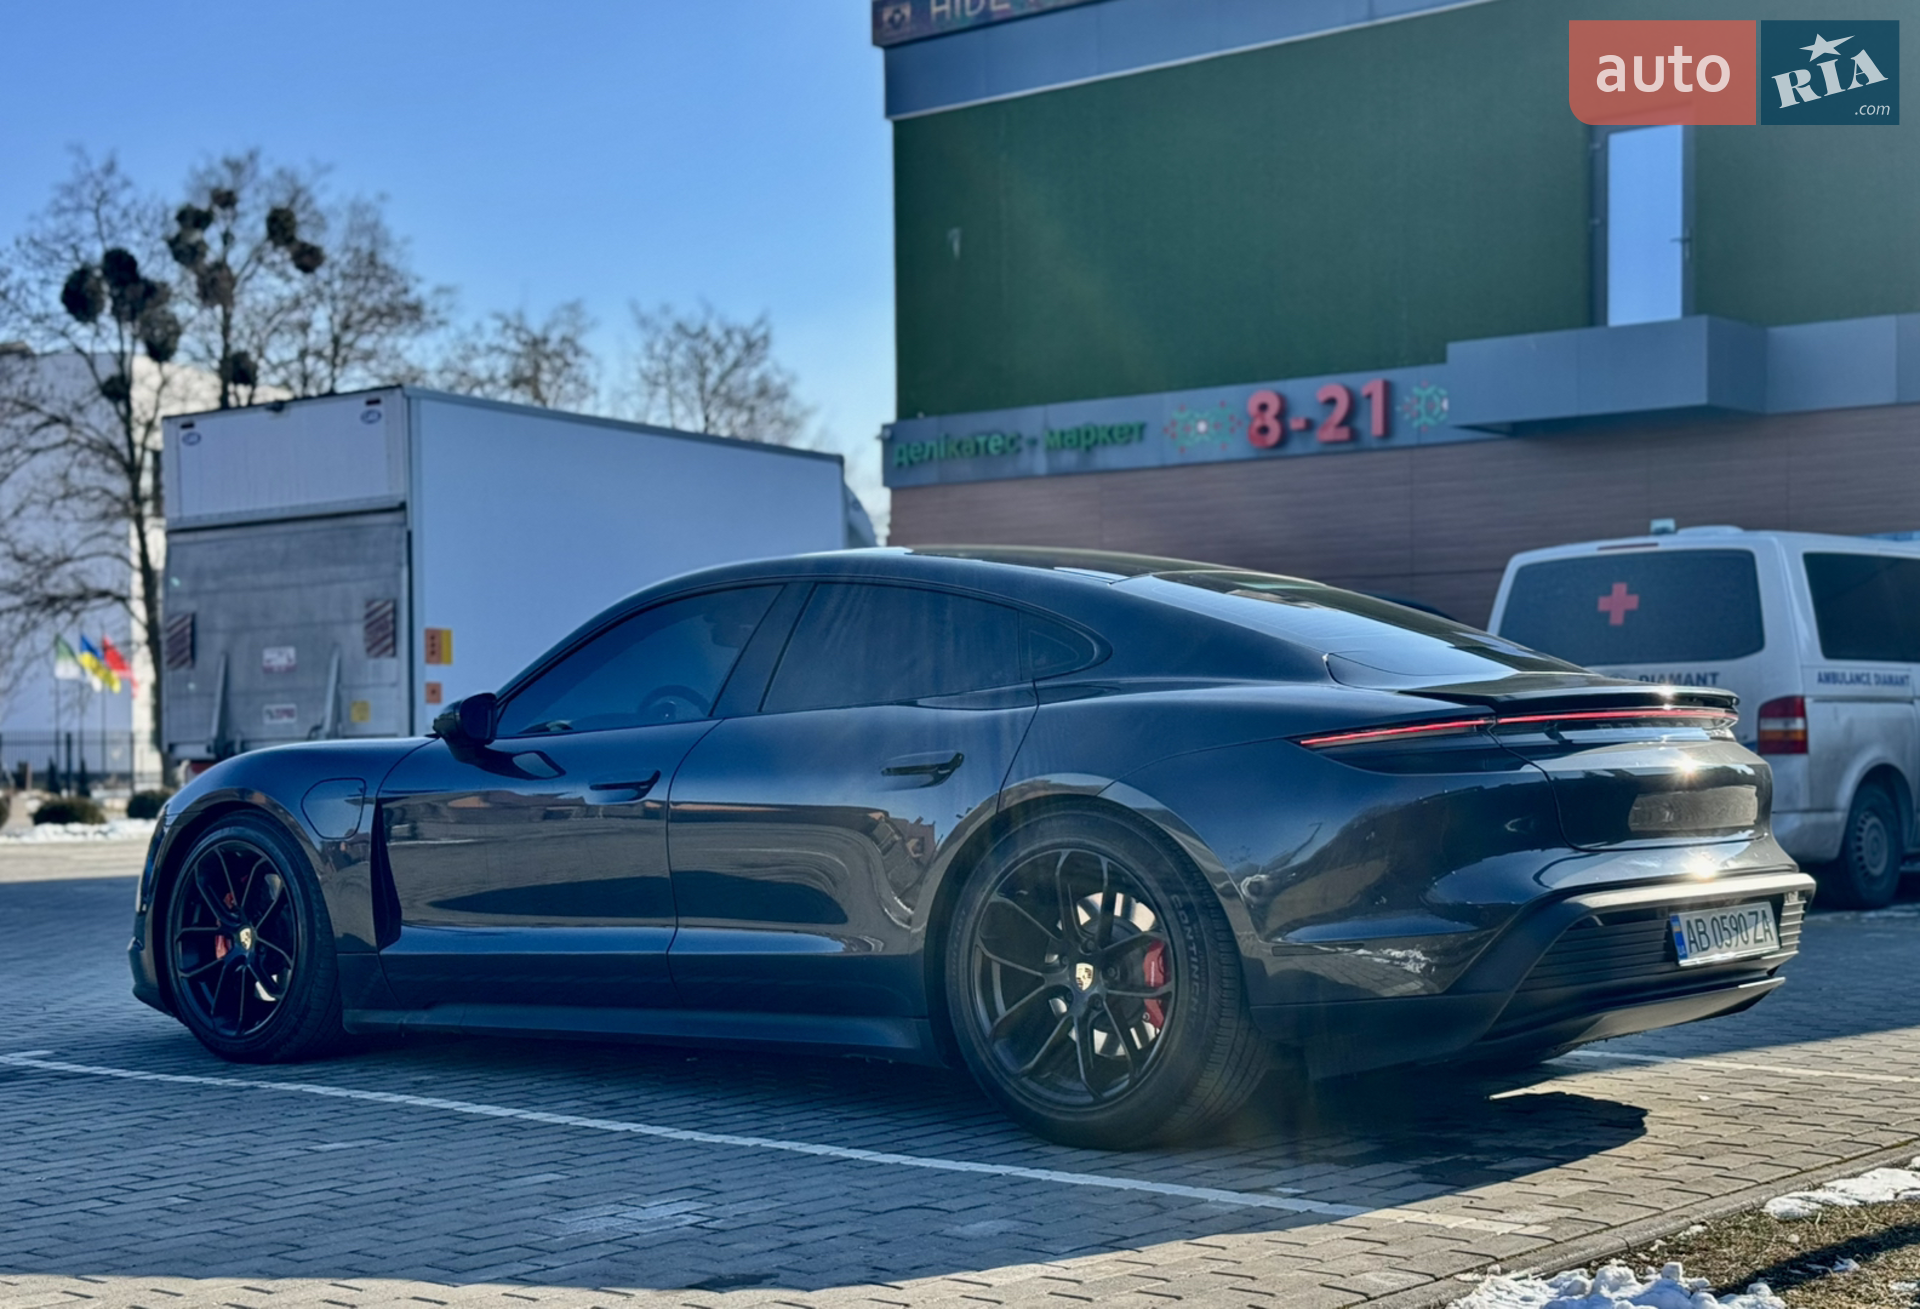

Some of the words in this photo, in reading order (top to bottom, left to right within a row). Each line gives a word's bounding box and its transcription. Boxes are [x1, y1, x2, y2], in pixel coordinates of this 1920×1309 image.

[1043, 421, 1147, 452] маркет
[1817, 671, 1872, 686] AMBULANCE
[1873, 672, 1910, 687] DIAMANT
[1685, 917, 1711, 954] AB
[1711, 912, 1750, 950] 0590
[1747, 909, 1774, 944] ZA
